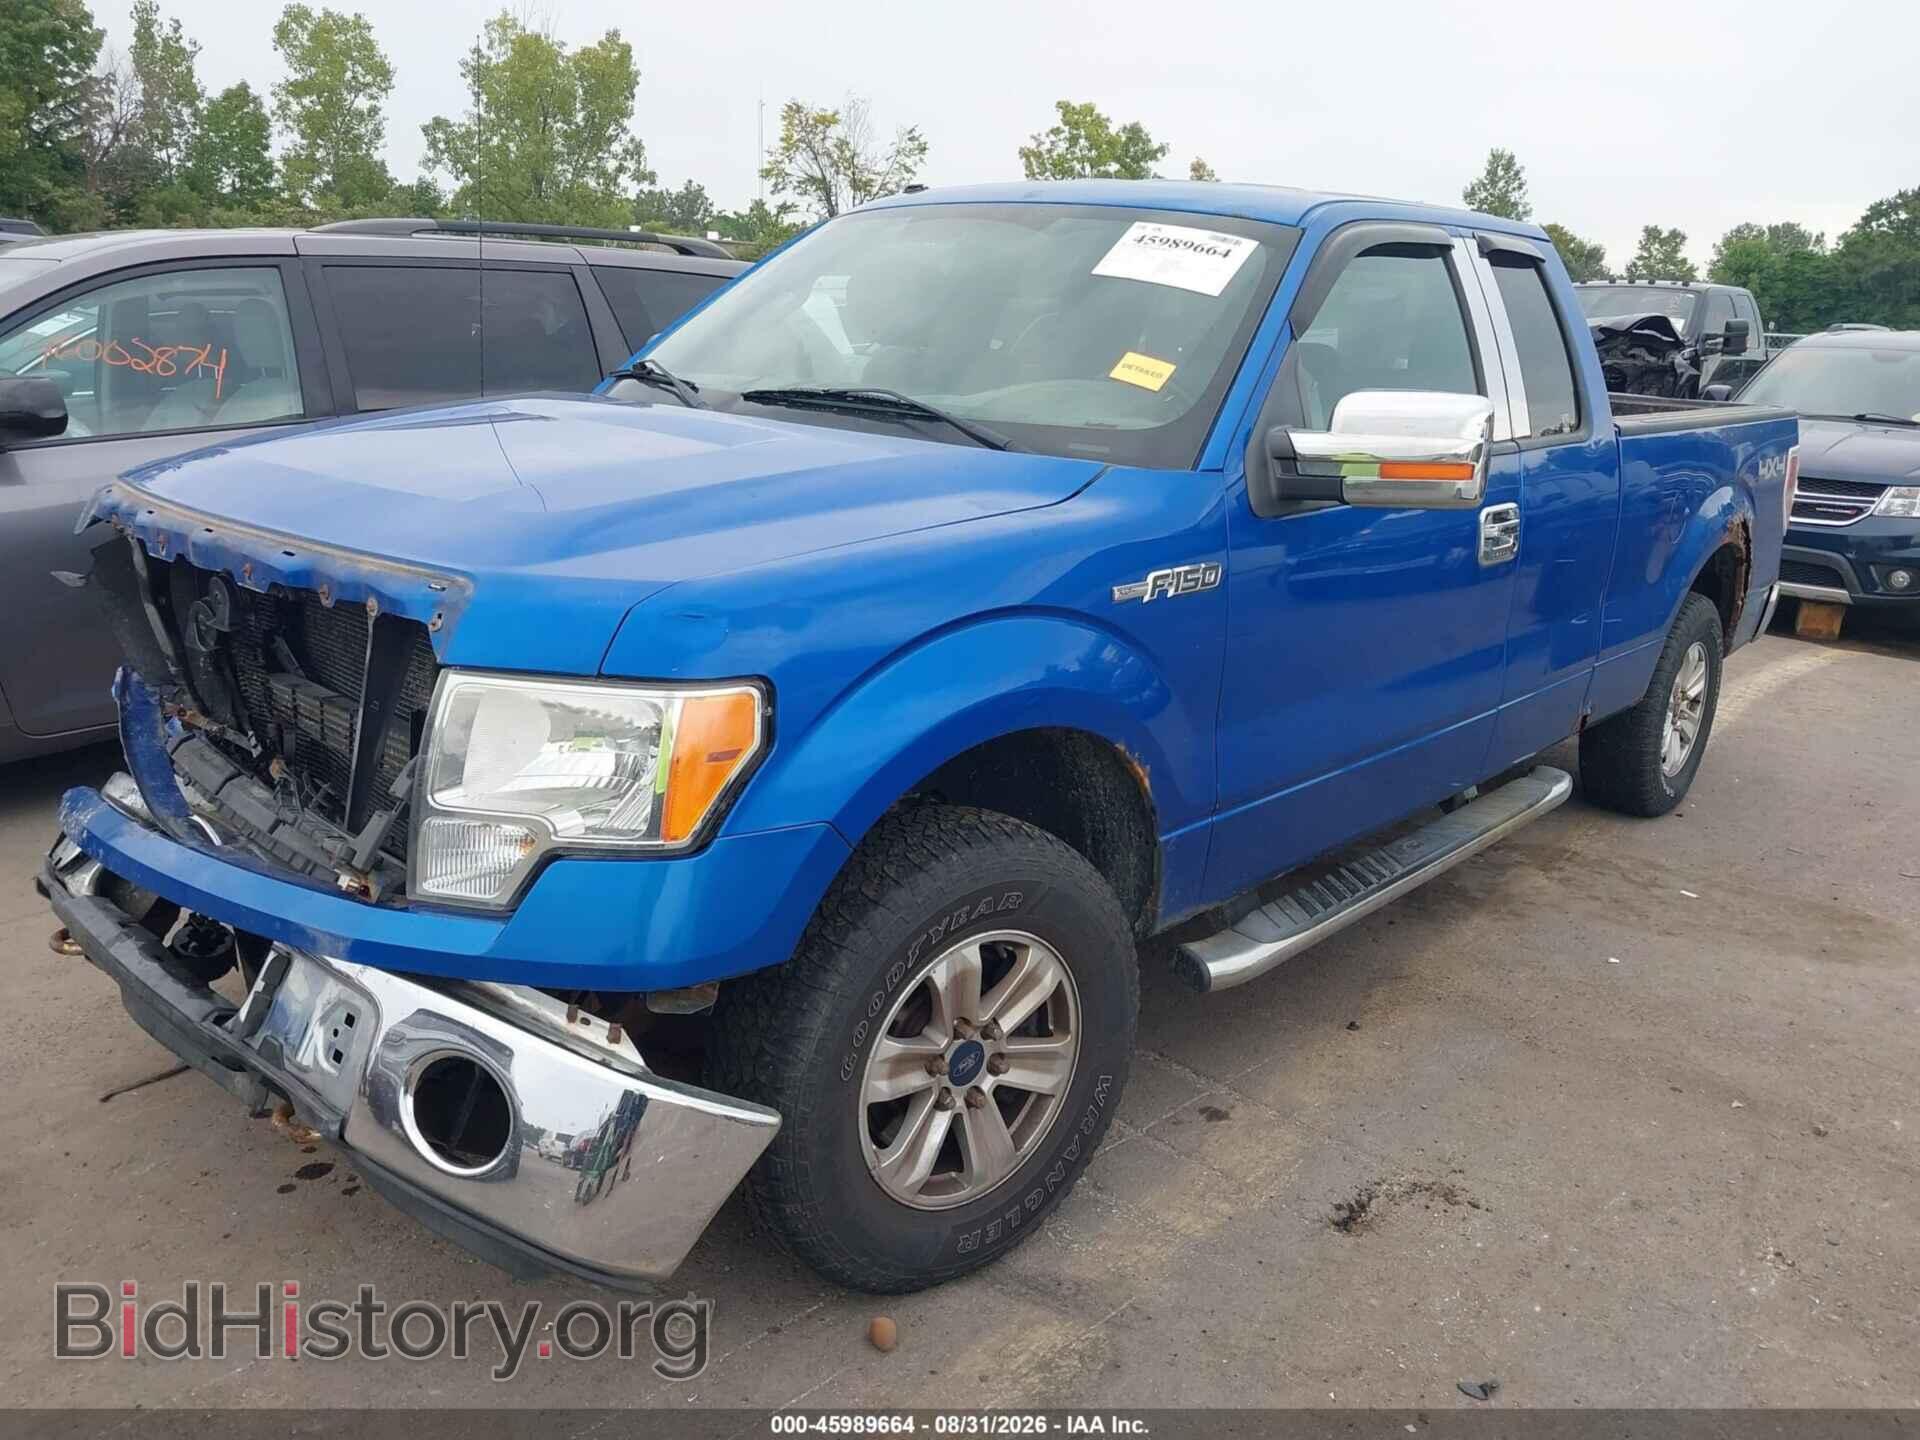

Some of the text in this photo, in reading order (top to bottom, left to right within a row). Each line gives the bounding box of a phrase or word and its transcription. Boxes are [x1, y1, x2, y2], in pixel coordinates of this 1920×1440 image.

[1133, 233, 1233, 259] 45989664
[840, 891, 1024, 1082] GOODYEAR
[956, 1074, 1113, 1254] WRANGLER
